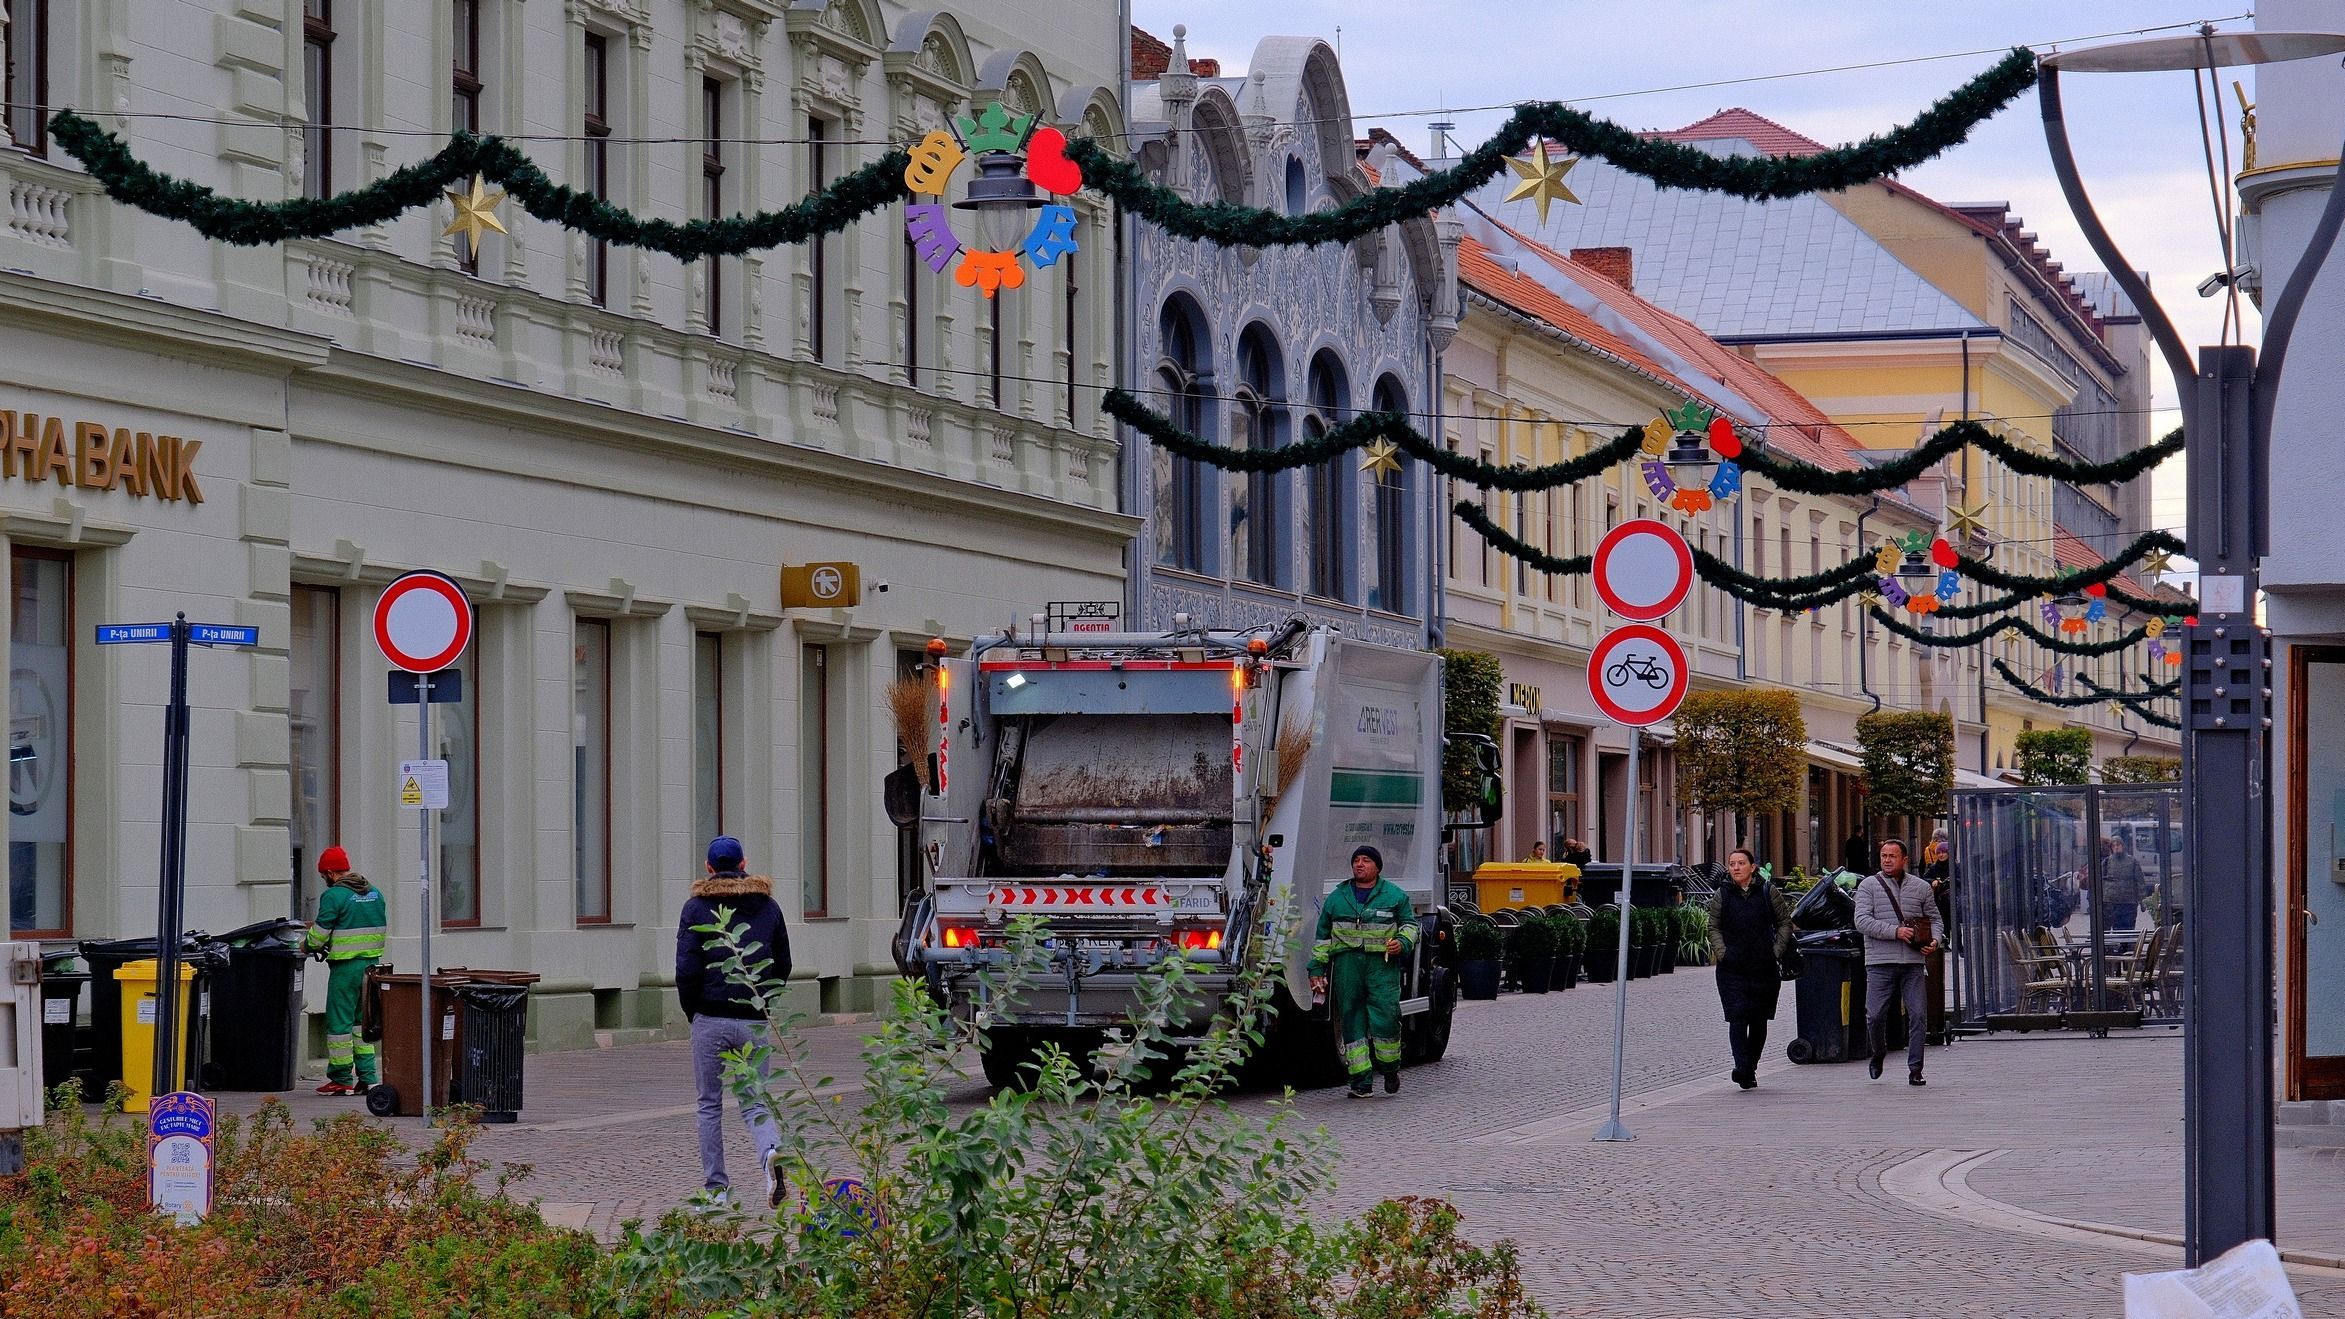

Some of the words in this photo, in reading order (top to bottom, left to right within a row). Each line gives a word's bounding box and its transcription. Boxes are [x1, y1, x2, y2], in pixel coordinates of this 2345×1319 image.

[76, 421, 204, 504] BANK
[1073, 623, 1110, 632] AGENTIA
[130, 628, 157, 639] UNIRII
[220, 630, 245, 641] UNIRII
[1511, 683, 1542, 715] MERON
[1180, 897, 1210, 908] FARID
